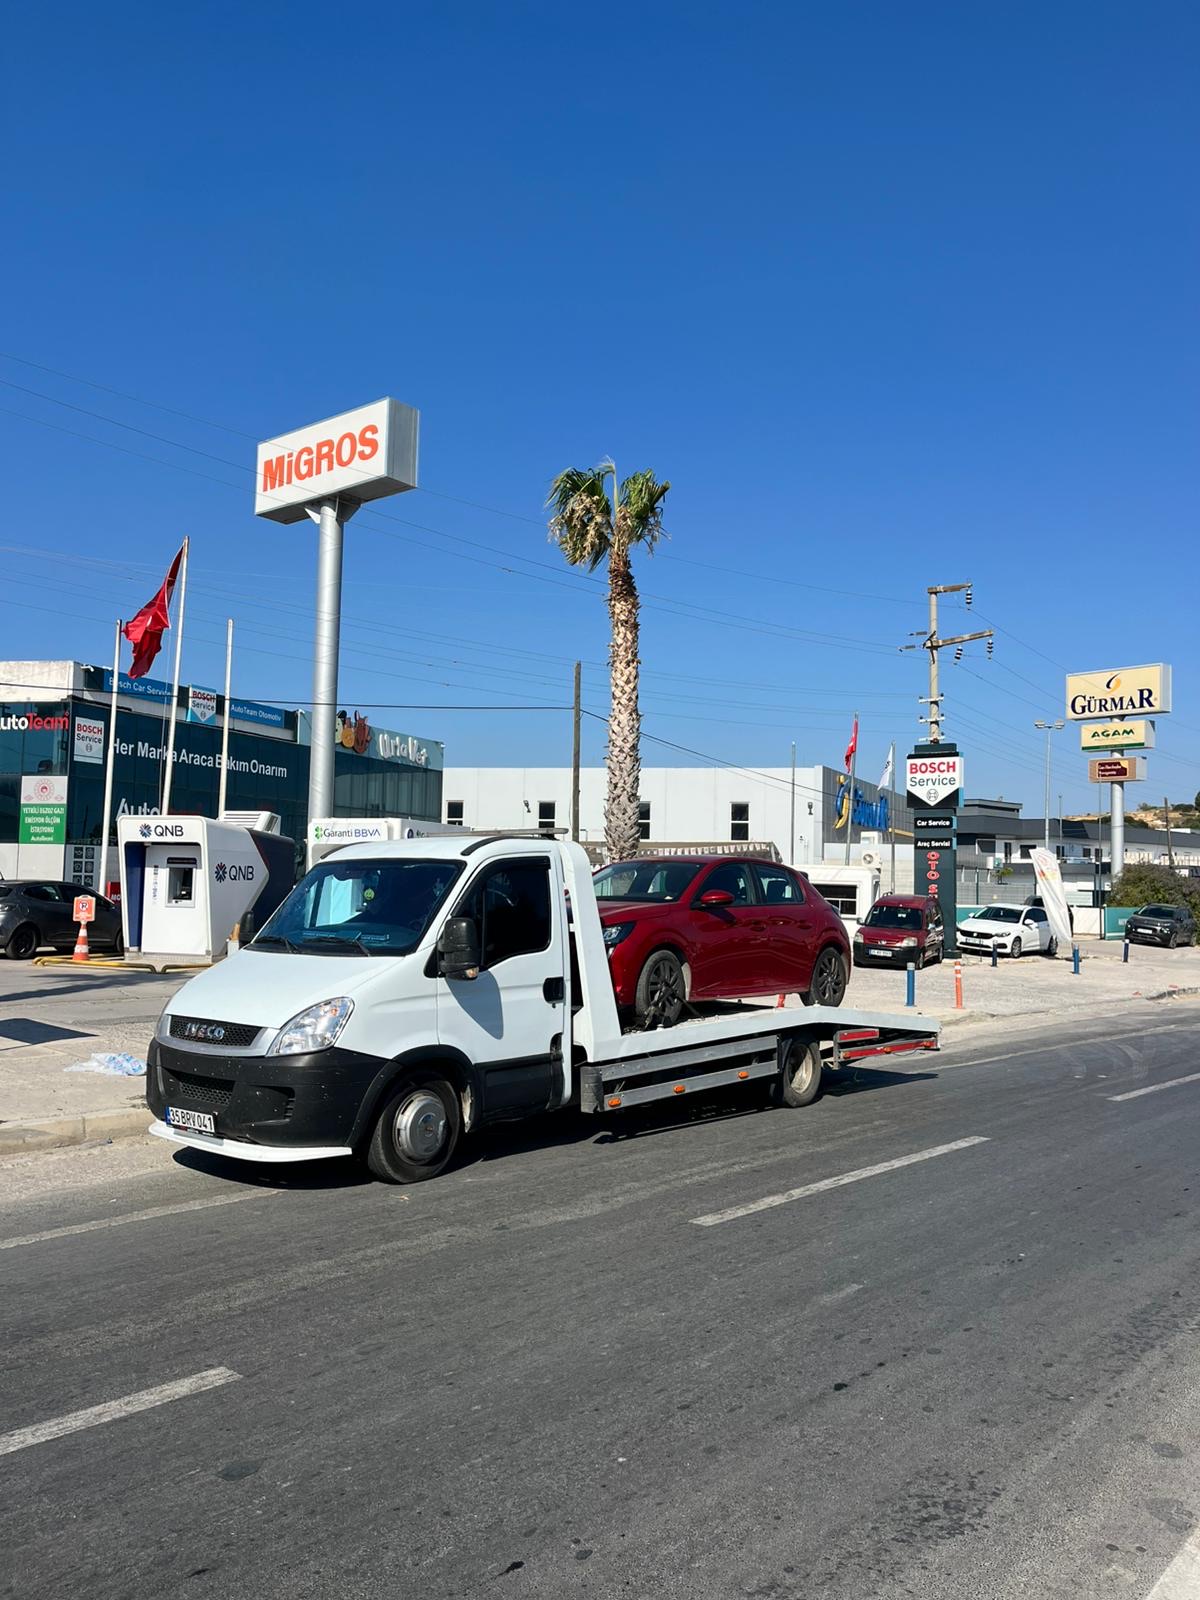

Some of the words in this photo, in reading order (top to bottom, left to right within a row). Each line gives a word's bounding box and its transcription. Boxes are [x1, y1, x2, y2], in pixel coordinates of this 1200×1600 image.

[133, 681, 145, 692] Car
[192, 690, 215, 703] BOSCH
[1070, 687, 1155, 715] GÜRMAR
[192, 700, 215, 711] Service
[0, 713, 69, 731] utoTeam
[76, 723, 103, 735] BOSCH
[76, 733, 102, 744] Service
[113, 737, 135, 756] Her
[179, 748, 214, 768] Araca
[250, 760, 288, 778] Onarım
[909, 761, 956, 774] BOSCH
[909, 775, 956, 787] Service
[916, 819, 927, 827] Car
[154, 825, 184, 837] QNB
[323, 828, 353, 838] Garanti
[354, 829, 380, 837] BBVA
[926, 851, 940, 880] OTO
[228, 865, 255, 881] QNB
[185, 1022, 225, 1040] IVECO
